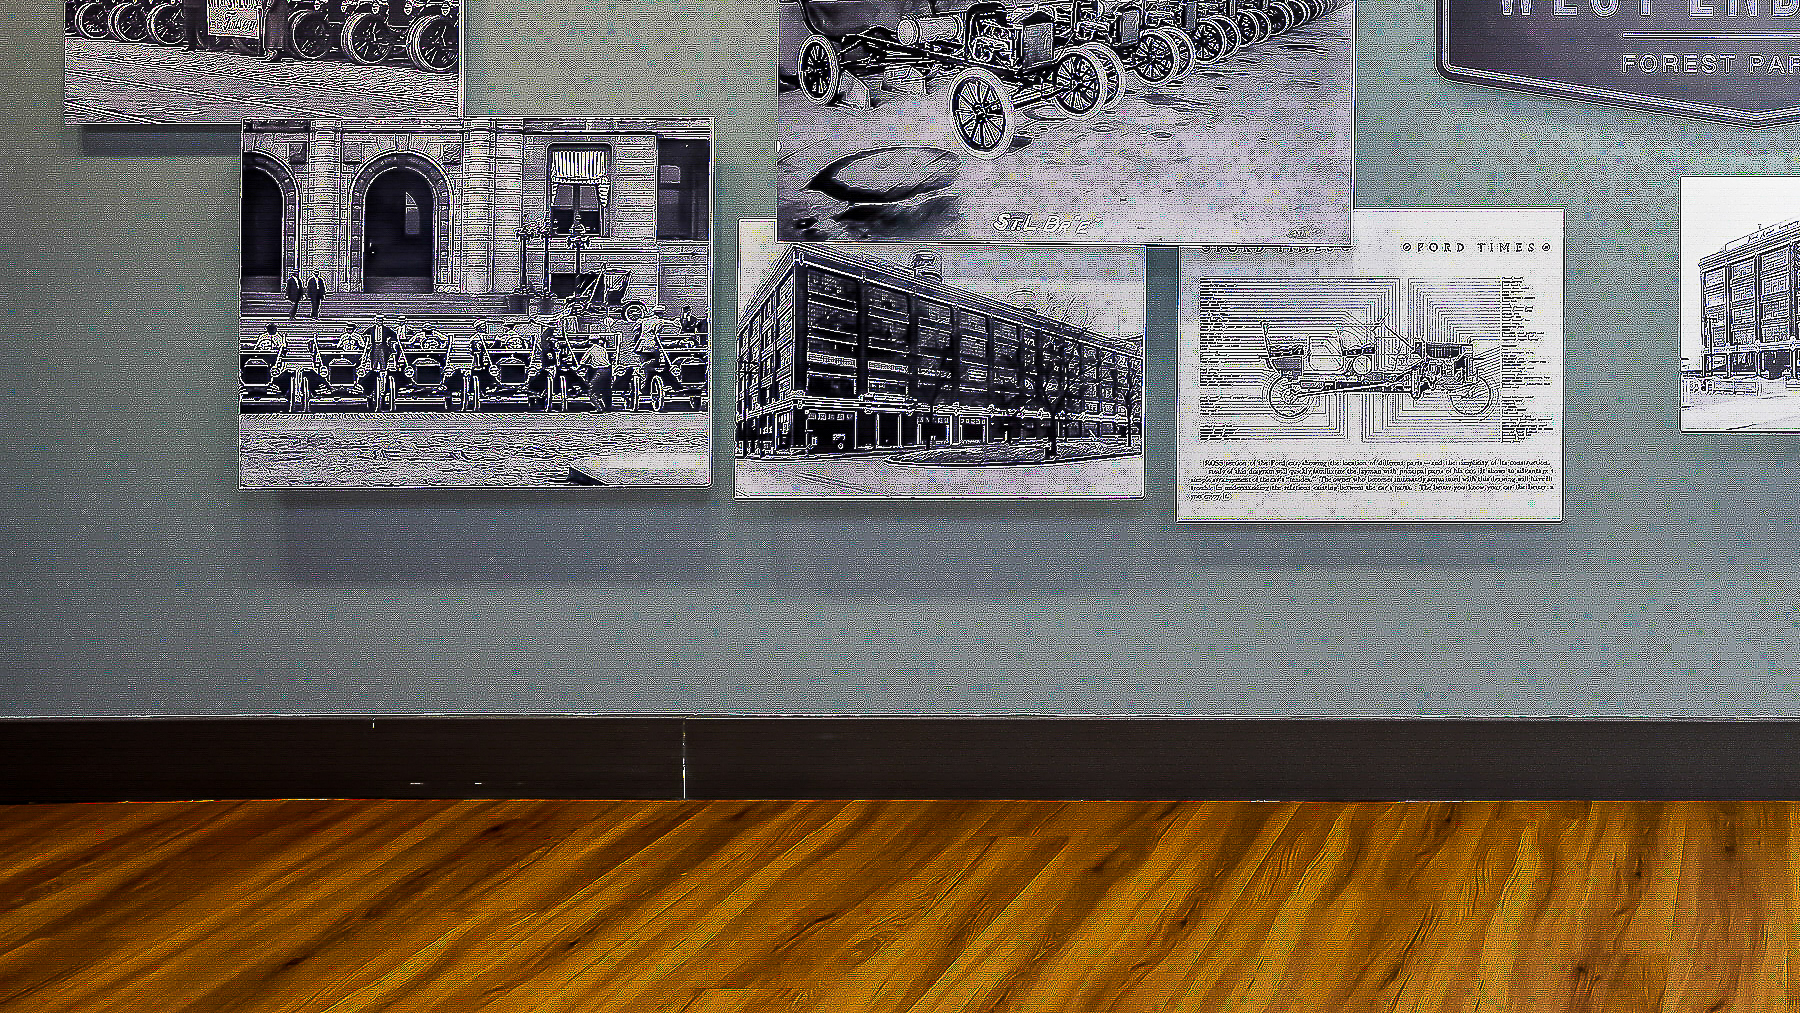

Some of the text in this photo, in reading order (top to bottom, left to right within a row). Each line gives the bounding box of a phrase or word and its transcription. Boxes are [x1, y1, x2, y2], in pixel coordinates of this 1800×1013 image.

[1622, 54, 1736, 74] FOREST
[1417, 242, 1535, 253] FORD TIMES
